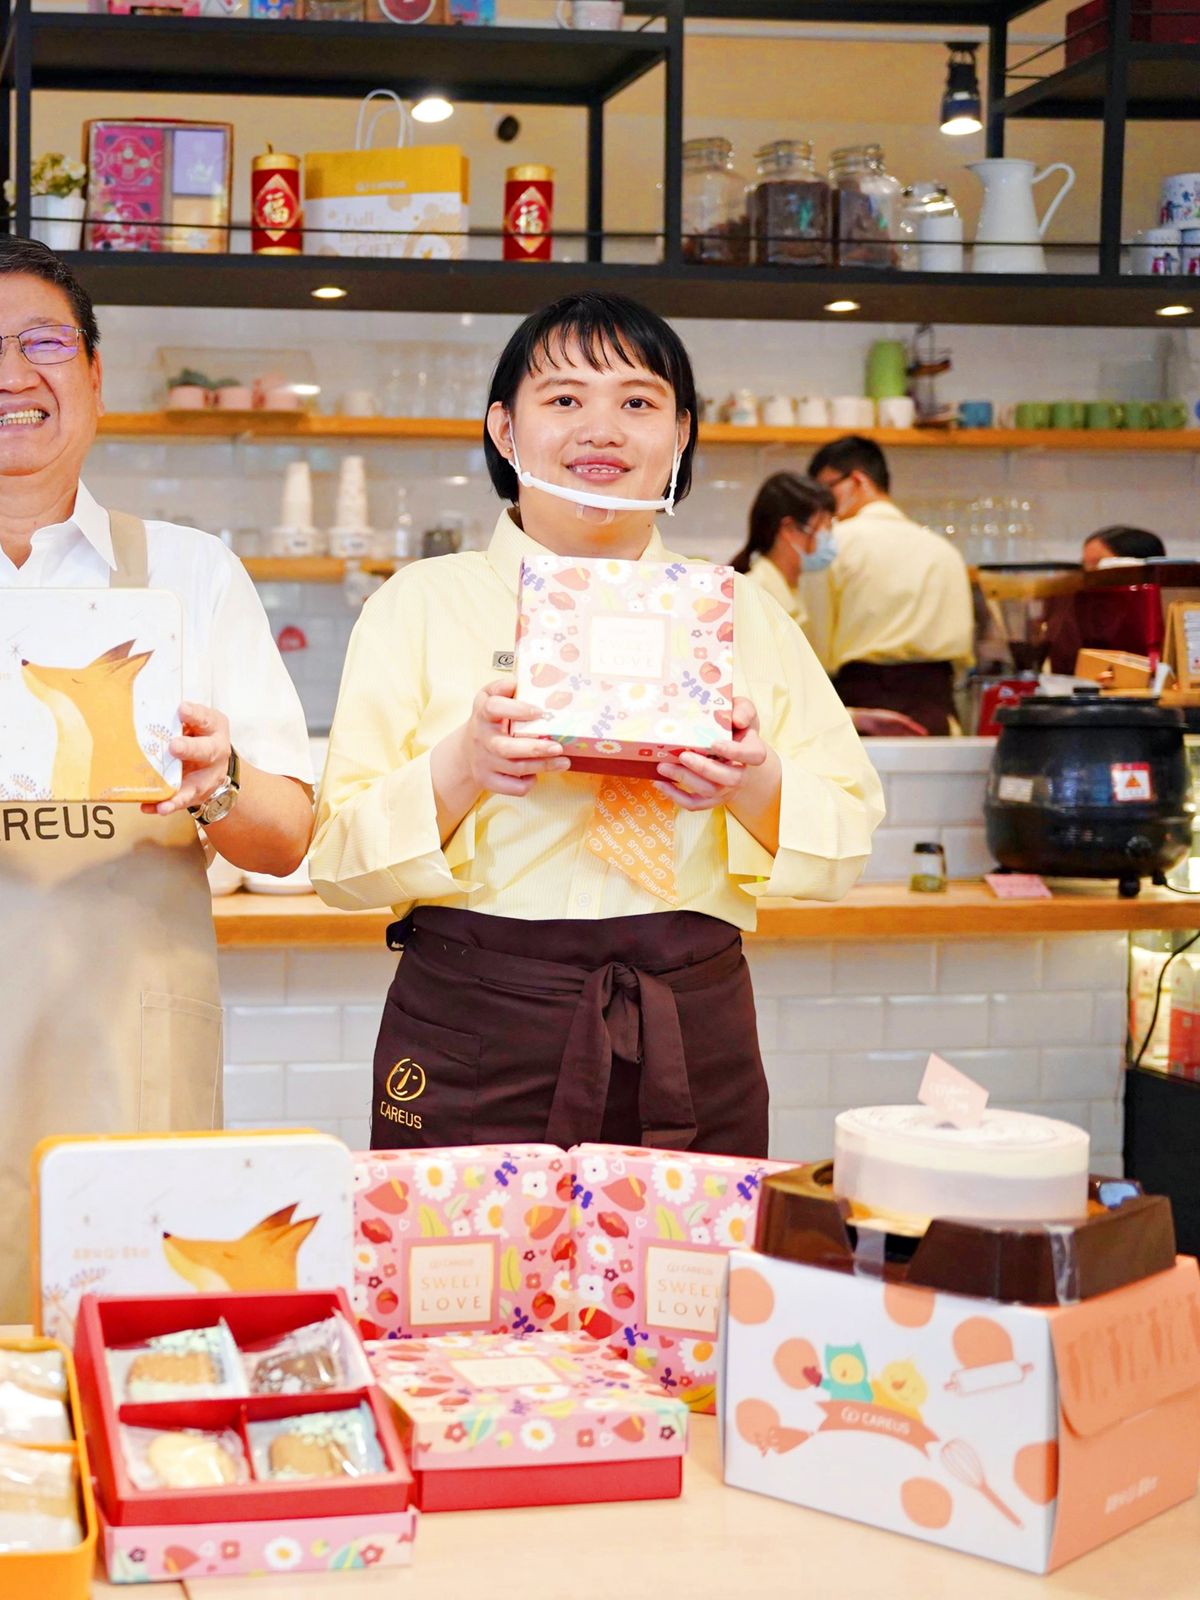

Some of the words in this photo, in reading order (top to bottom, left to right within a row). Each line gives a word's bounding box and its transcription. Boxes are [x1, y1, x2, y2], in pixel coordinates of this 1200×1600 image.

[380, 1101, 422, 1129] CAREUS
[421, 1275, 482, 1290] SWEET
[420, 1295, 481, 1312] LOVE
